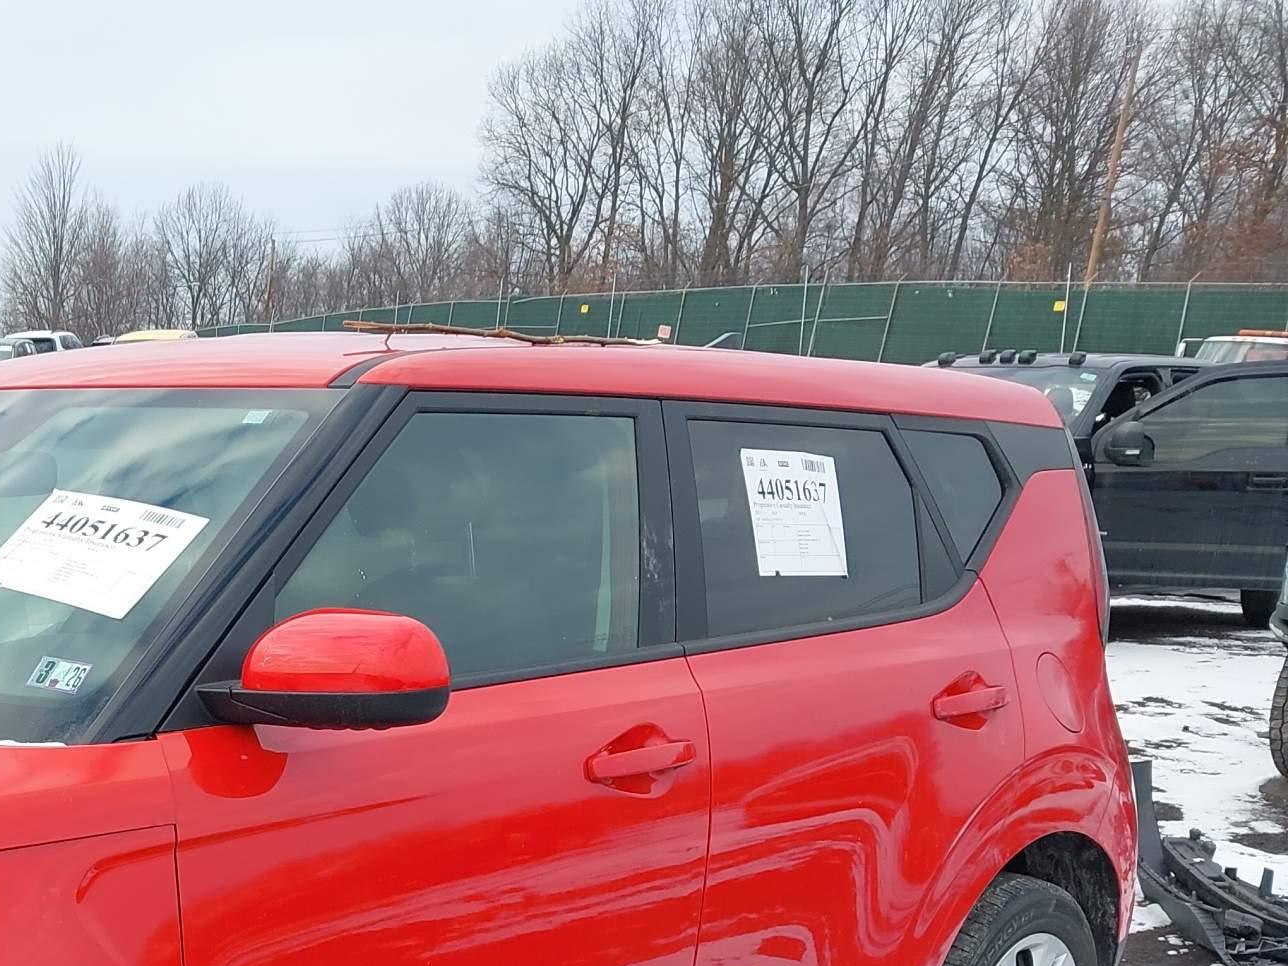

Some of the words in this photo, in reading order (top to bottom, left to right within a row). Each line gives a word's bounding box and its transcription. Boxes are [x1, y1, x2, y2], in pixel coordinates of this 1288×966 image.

[757, 477, 826, 504] 44051637
[41, 511, 169, 552] 44051637
[65, 666, 87, 689] 26
